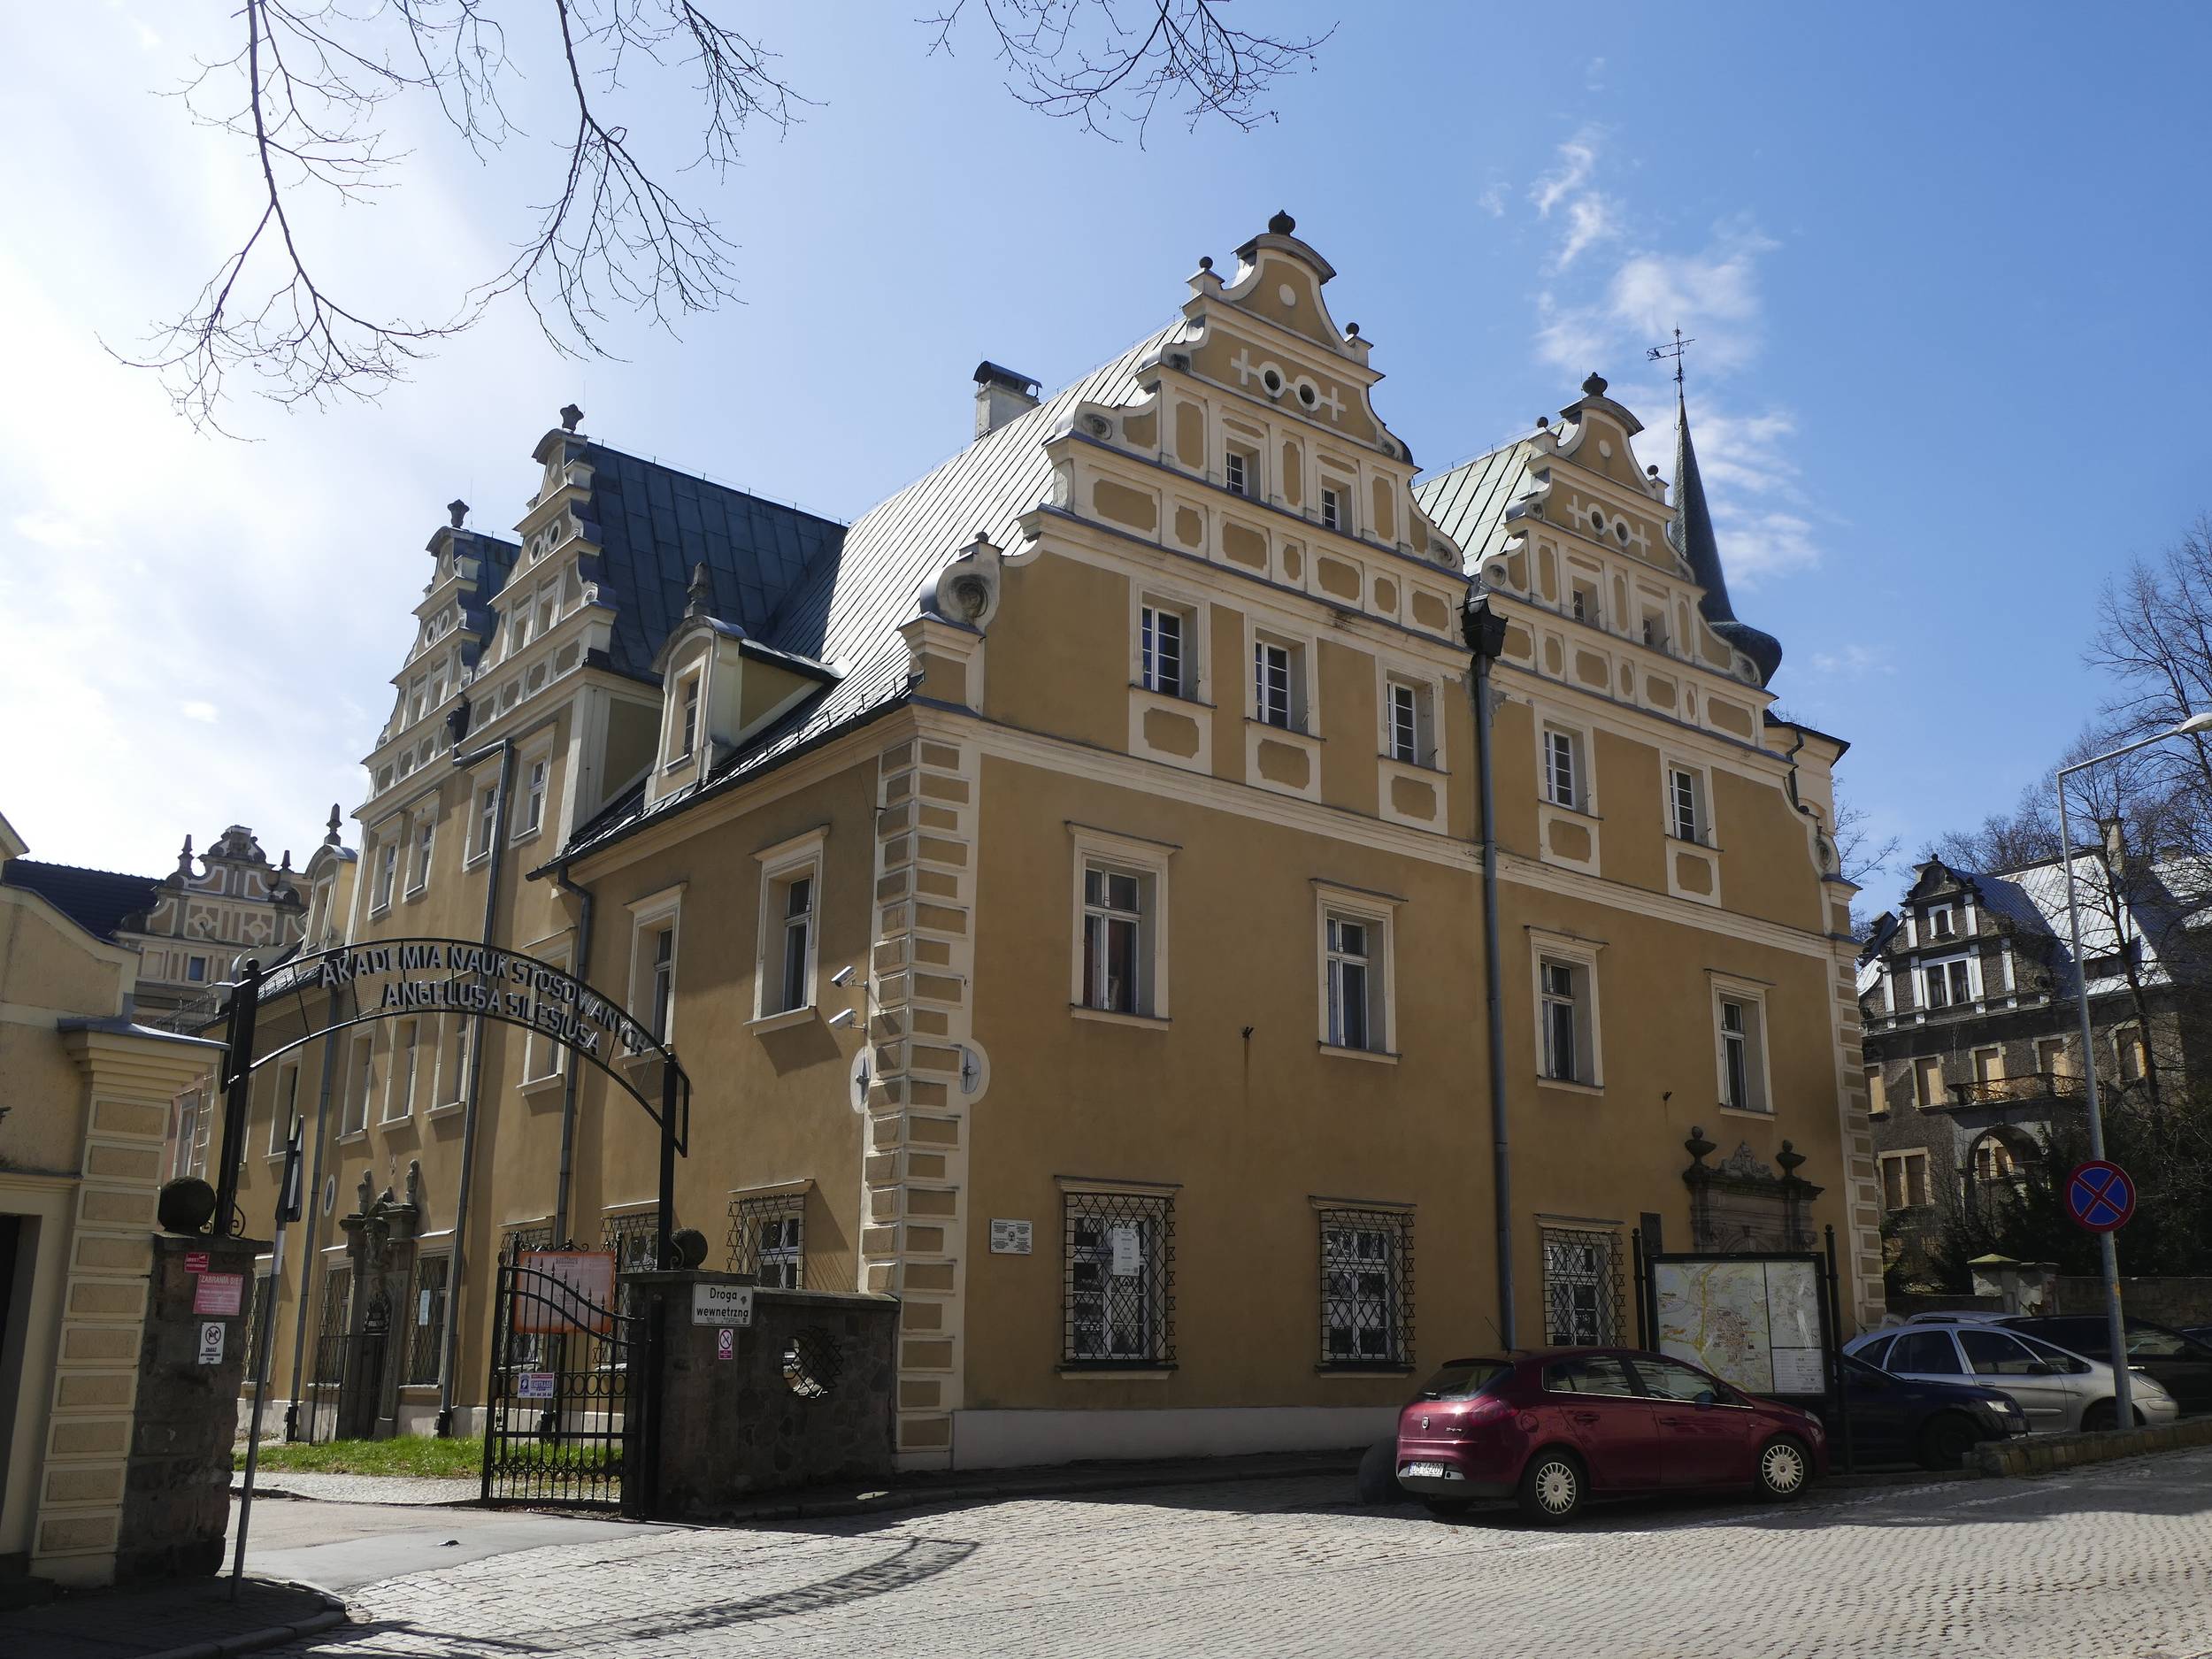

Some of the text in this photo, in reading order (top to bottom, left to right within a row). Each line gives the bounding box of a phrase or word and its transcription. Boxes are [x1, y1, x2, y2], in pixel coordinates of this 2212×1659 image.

[381, 982, 599, 1056] ANGELUSA SILESIUSA
[447, 946, 509, 979] NAUK
[511, 960, 647, 1056] STOSOWANYCH
[710, 1287, 737, 1302] Droga
